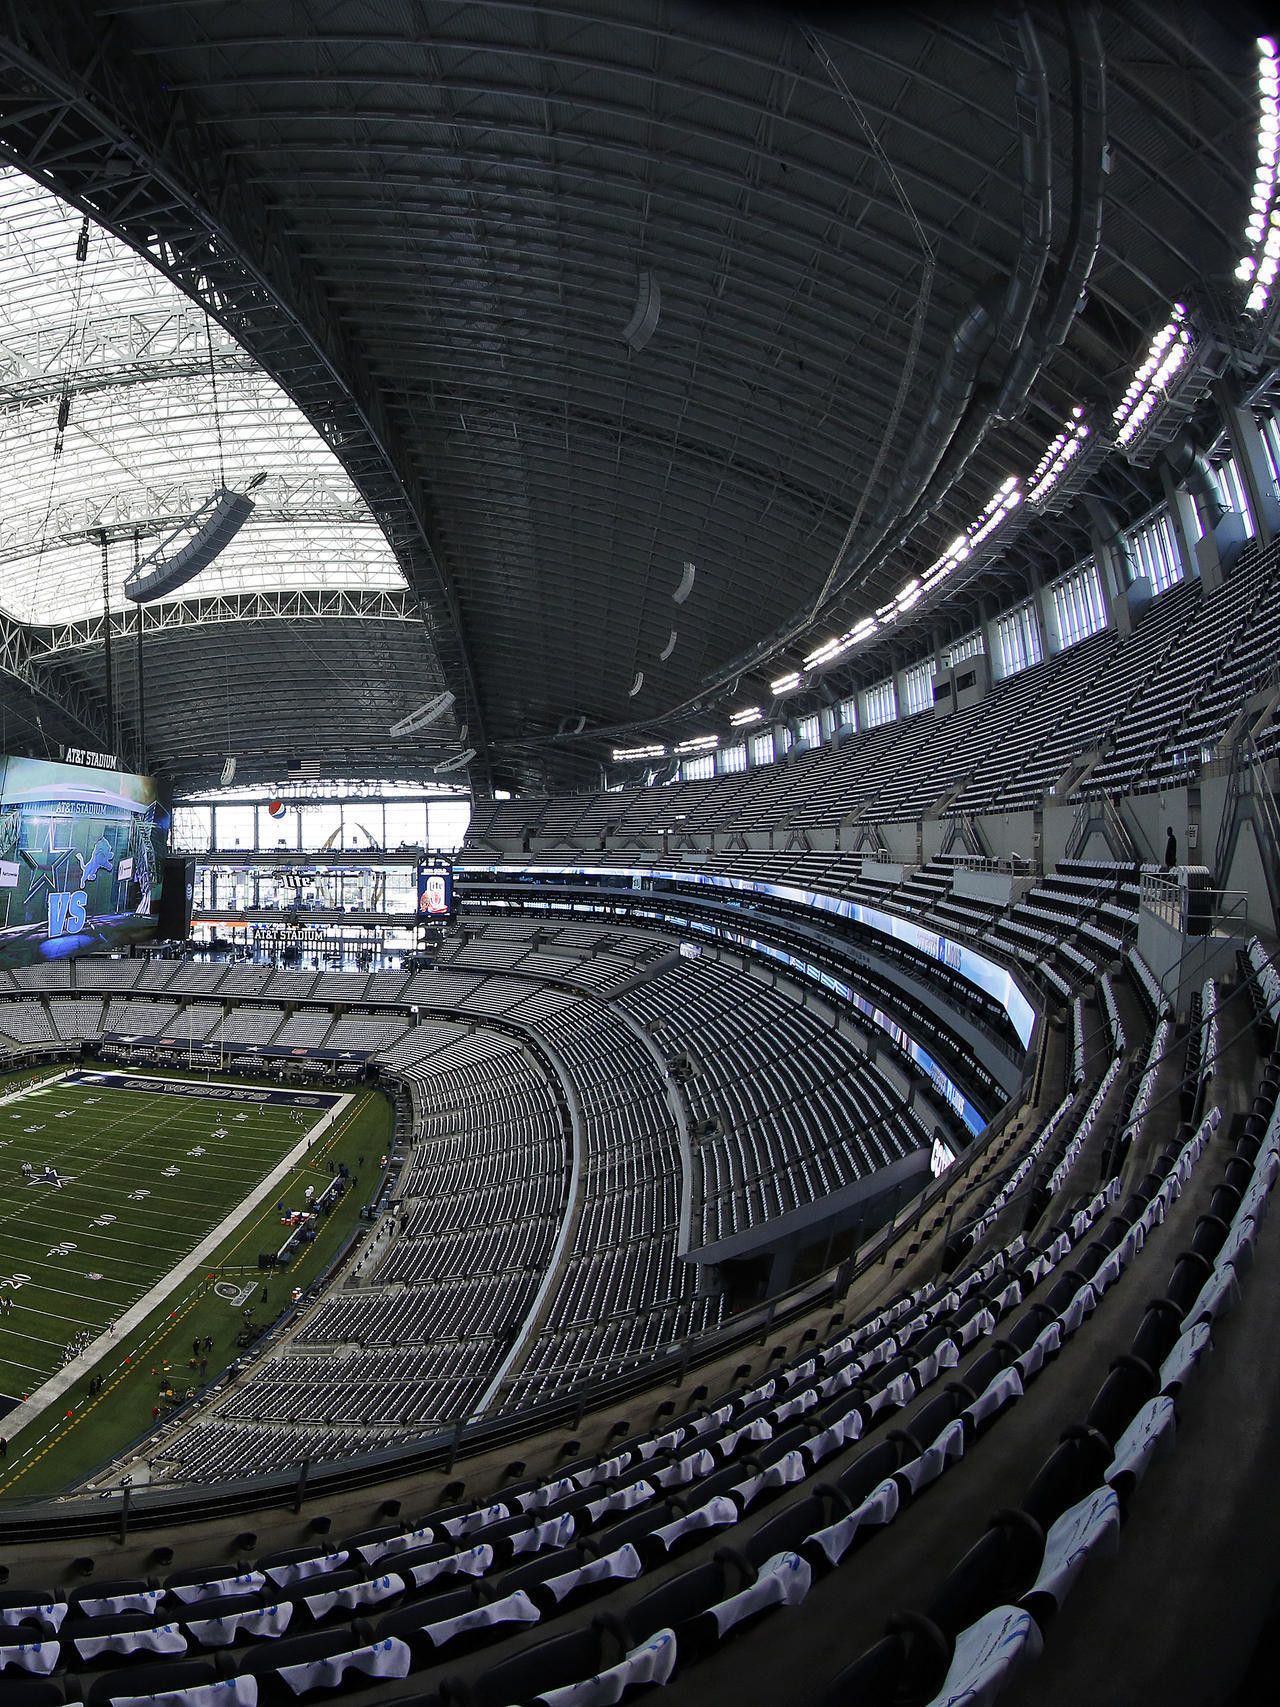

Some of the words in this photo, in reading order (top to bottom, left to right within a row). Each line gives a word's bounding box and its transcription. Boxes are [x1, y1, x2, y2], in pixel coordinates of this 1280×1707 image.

[65, 748, 86, 764] AT&T
[86, 751, 117, 769] STADIUM
[56, 802, 75, 813] AT&T
[76, 803, 107, 815] STADIUM
[289, 804, 323, 816] pepsi
[48, 891, 87, 938] VS
[254, 930, 278, 940] AT&T
[280, 930, 324, 940] STADIUM
[123, 1080, 271, 1100] COWBOYS
[93, 1214, 117, 1226] 40
[49, 1242, 78, 1256] 30
[0, 1273, 32, 1290] 20
